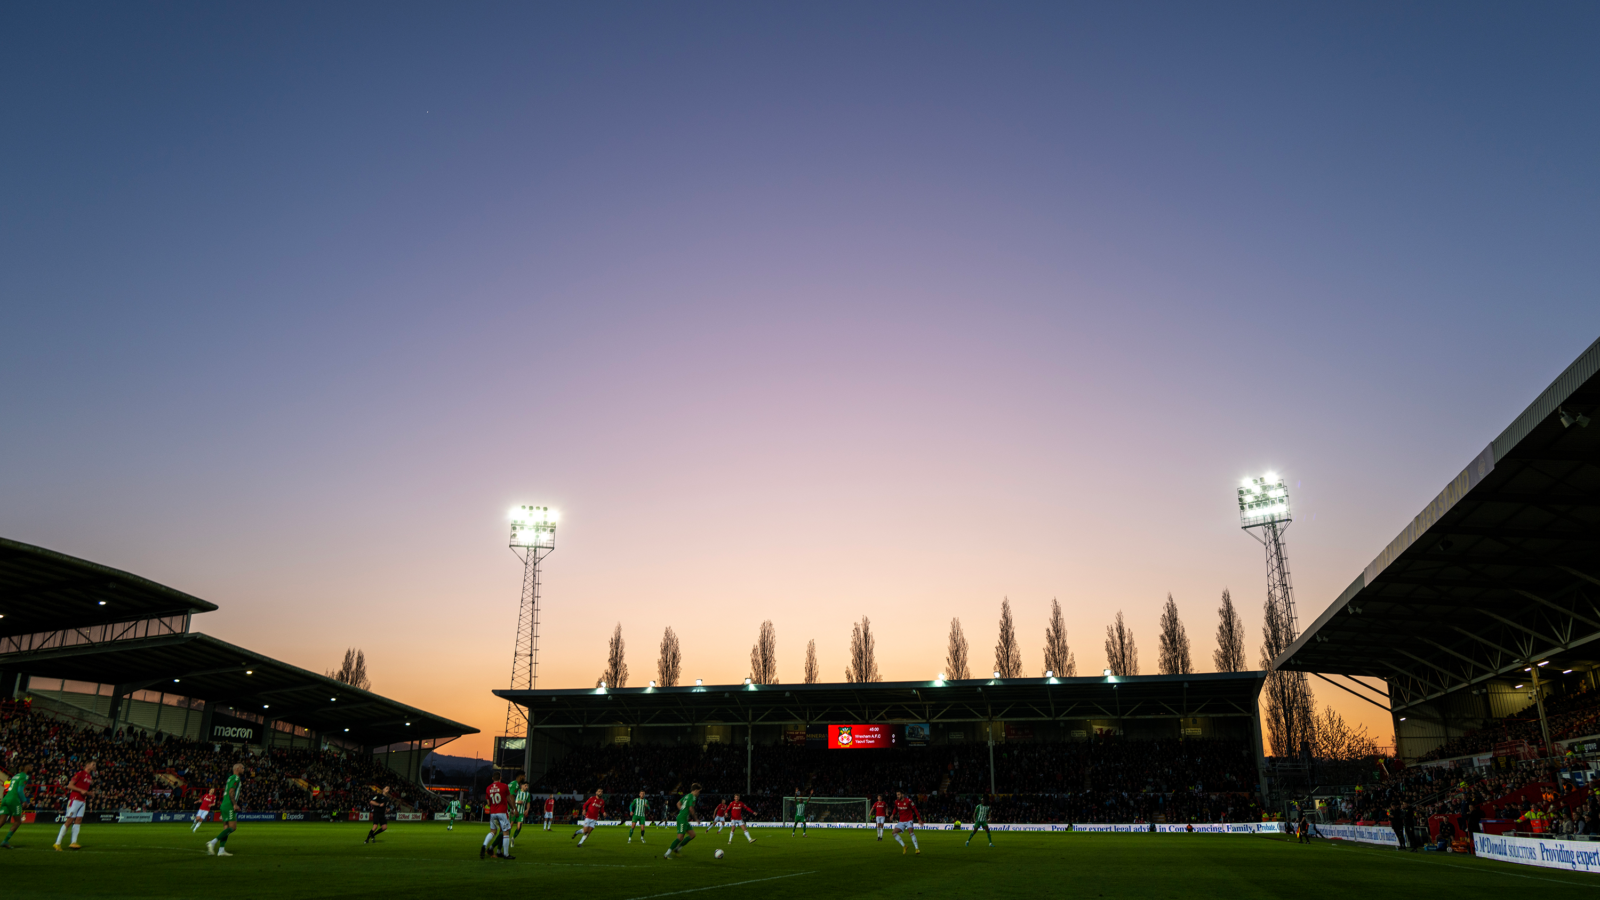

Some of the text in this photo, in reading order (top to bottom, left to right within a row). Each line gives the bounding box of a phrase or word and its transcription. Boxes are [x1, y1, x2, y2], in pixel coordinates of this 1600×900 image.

[213, 725, 253, 739] macron
[489, 792, 502, 805] 10
[286, 813, 305, 821] Expedia
[1479, 836, 1507, 856] McDonald
[1508, 845, 1537, 860] SOLICITORS
[1539, 842, 1577, 871] Providing
[1576, 848, 1600, 870] expert
